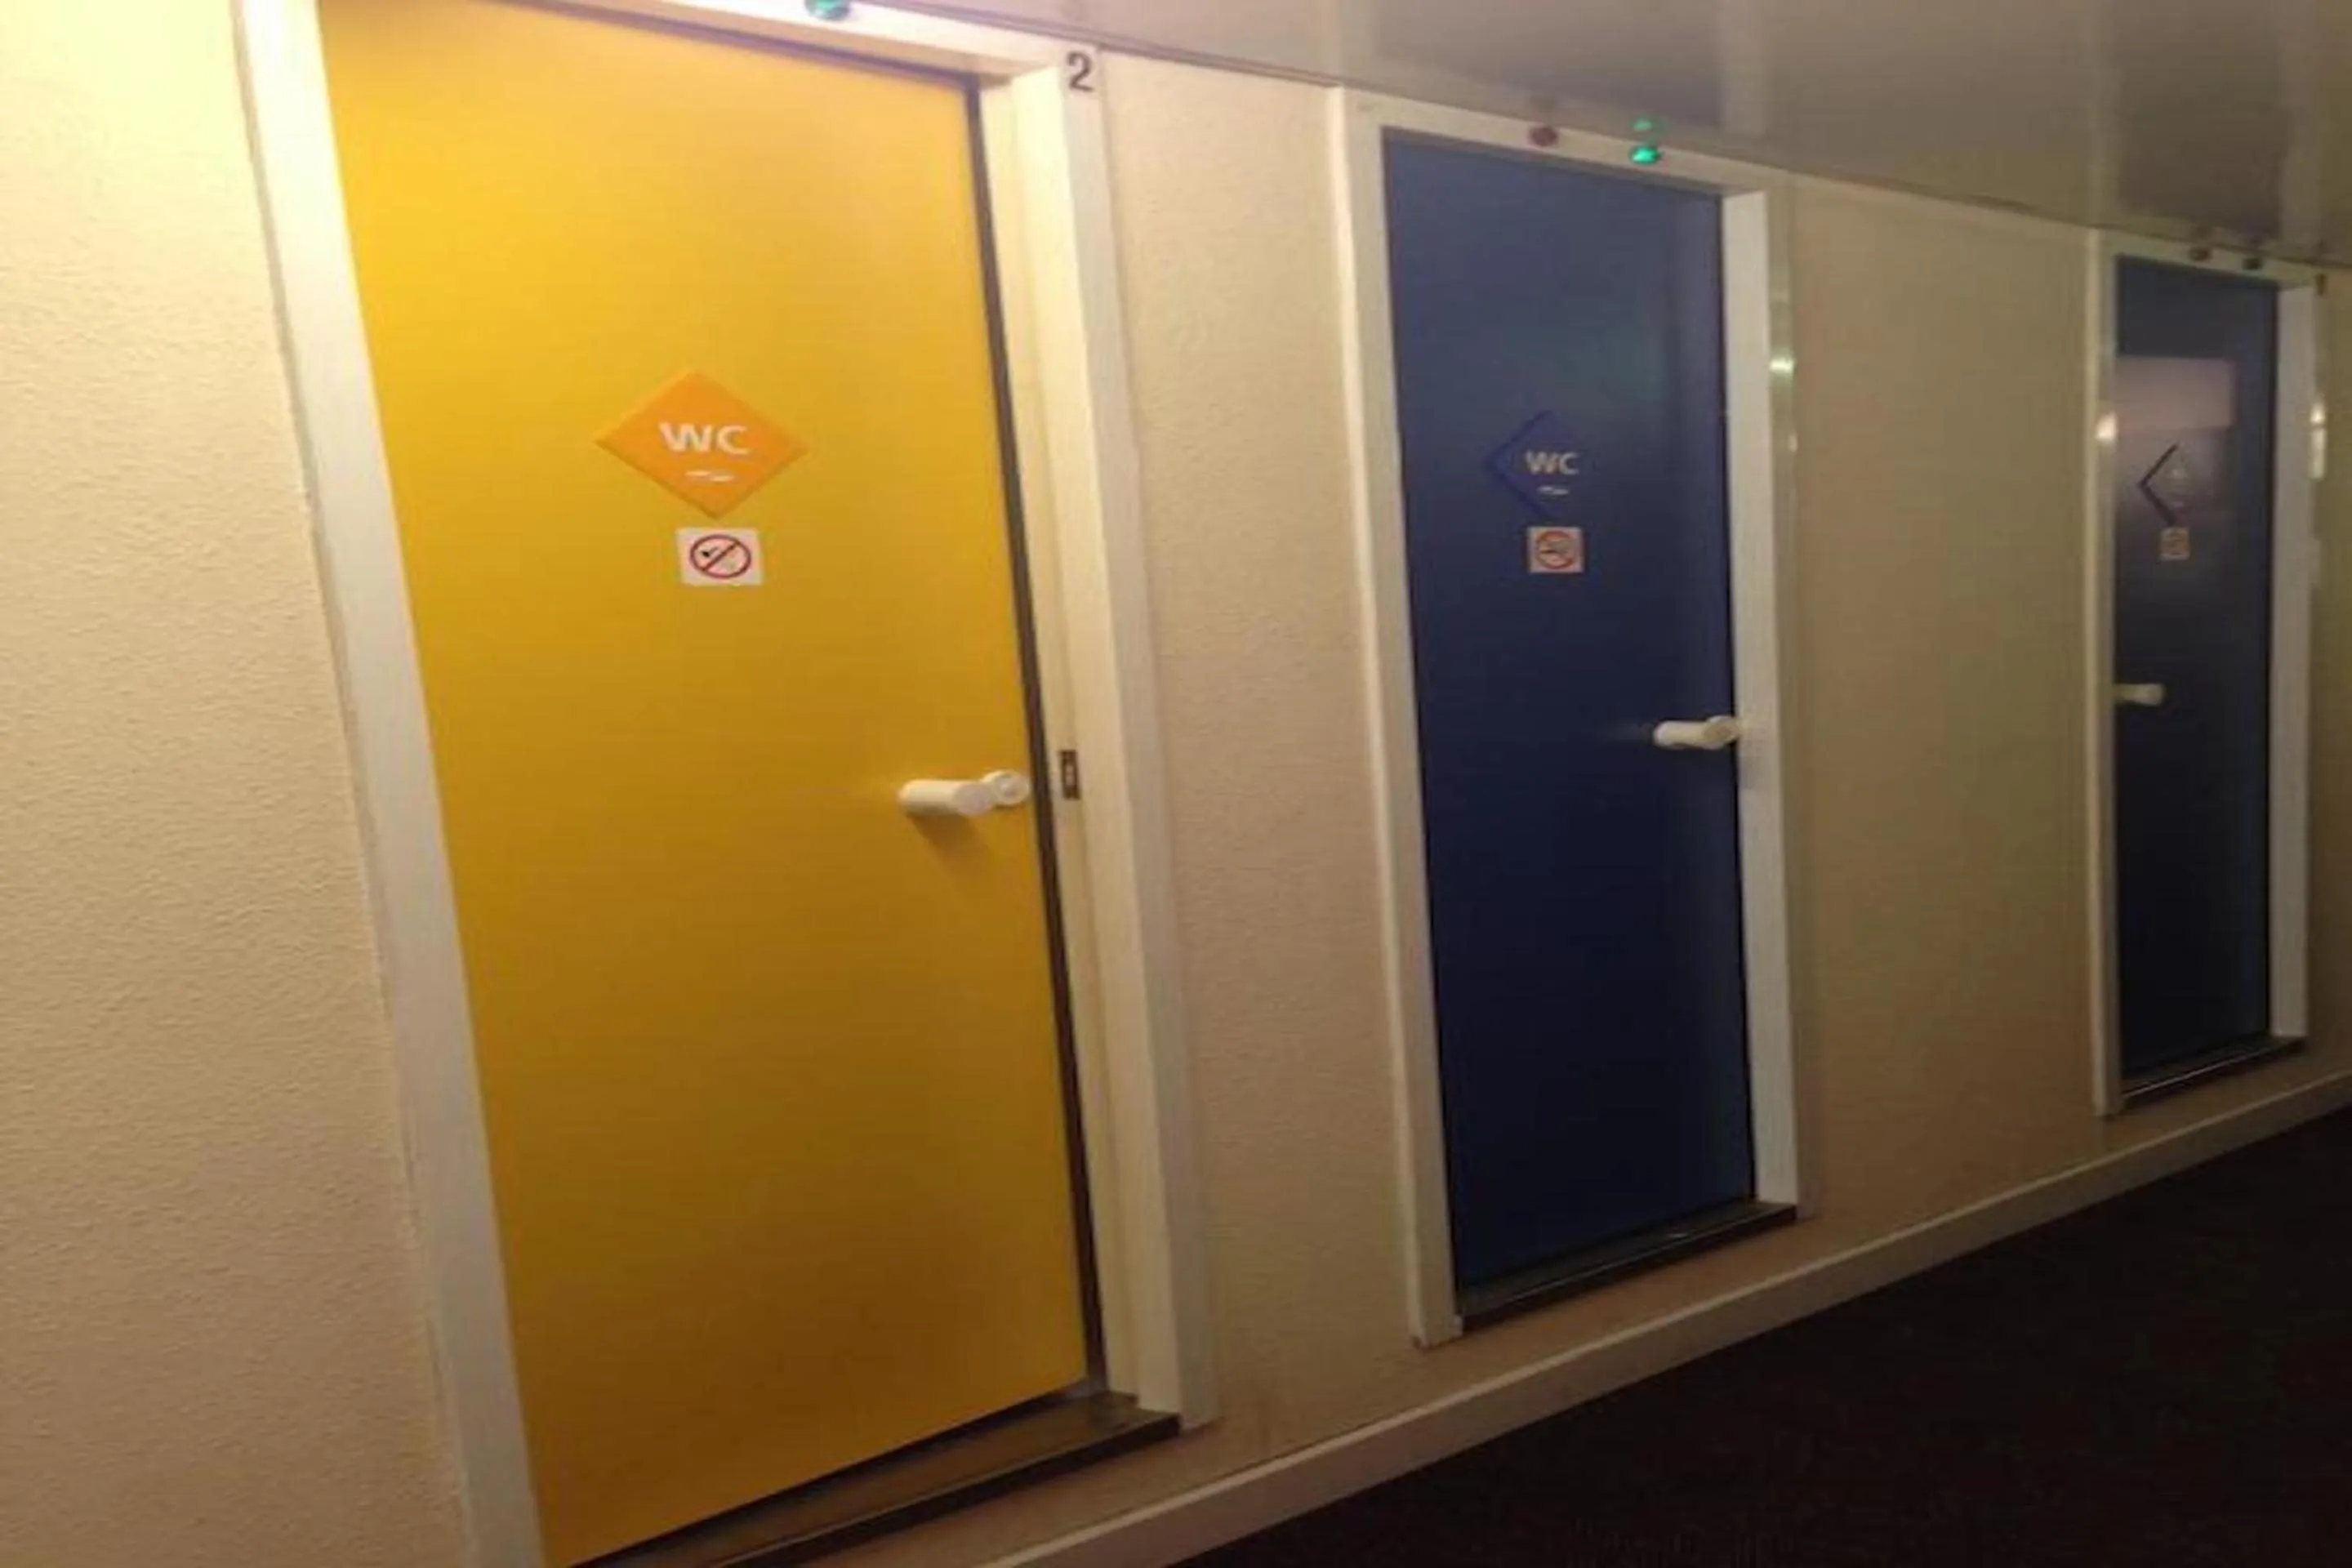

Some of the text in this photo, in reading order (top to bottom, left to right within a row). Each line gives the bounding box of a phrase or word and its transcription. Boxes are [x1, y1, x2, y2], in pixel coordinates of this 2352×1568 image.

[1066, 51, 1094, 92] 2
[658, 421, 749, 455] WC
[1525, 451, 1579, 474] WC
